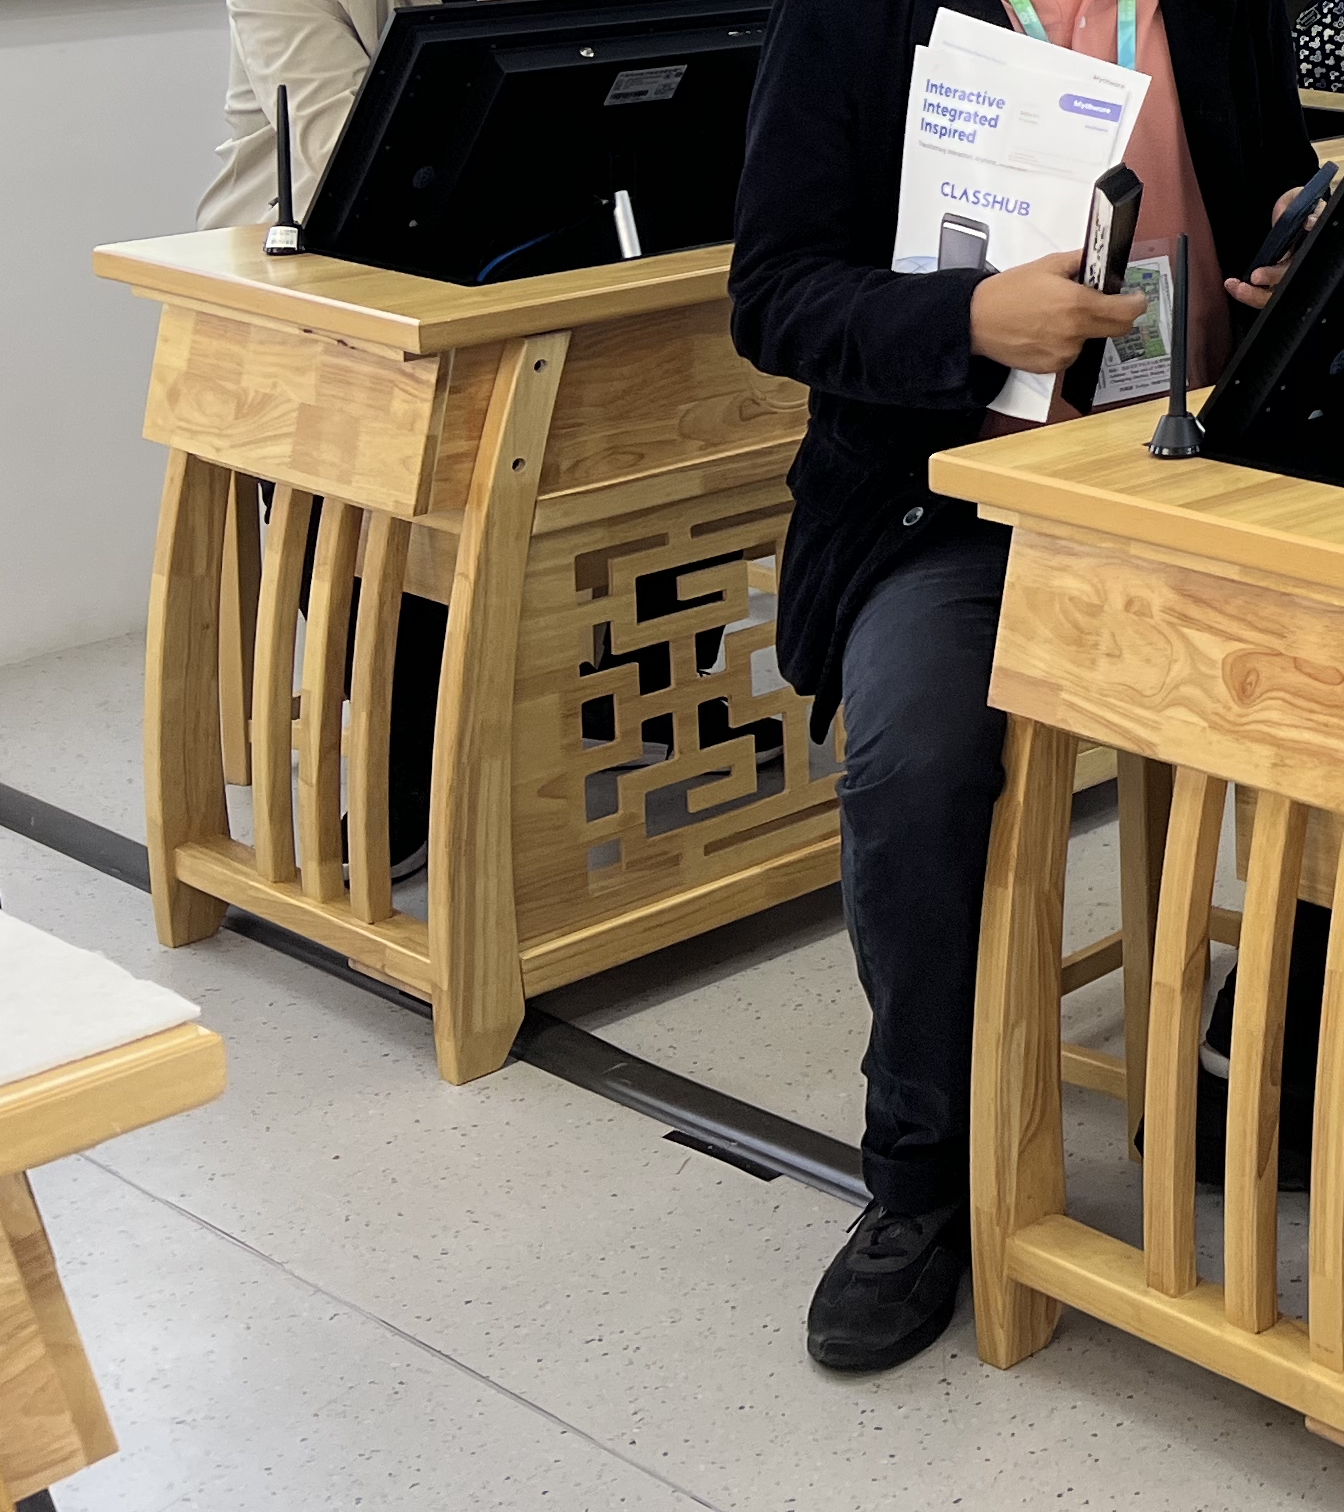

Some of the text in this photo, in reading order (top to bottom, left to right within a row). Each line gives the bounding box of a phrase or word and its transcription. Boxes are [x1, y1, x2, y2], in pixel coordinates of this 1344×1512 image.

[925, 78, 1006, 110] Interactive
[922, 97, 1000, 129] Integrated
[920, 116, 977, 144] Inspired
[940, 181, 1031, 218] CLASSHUB
